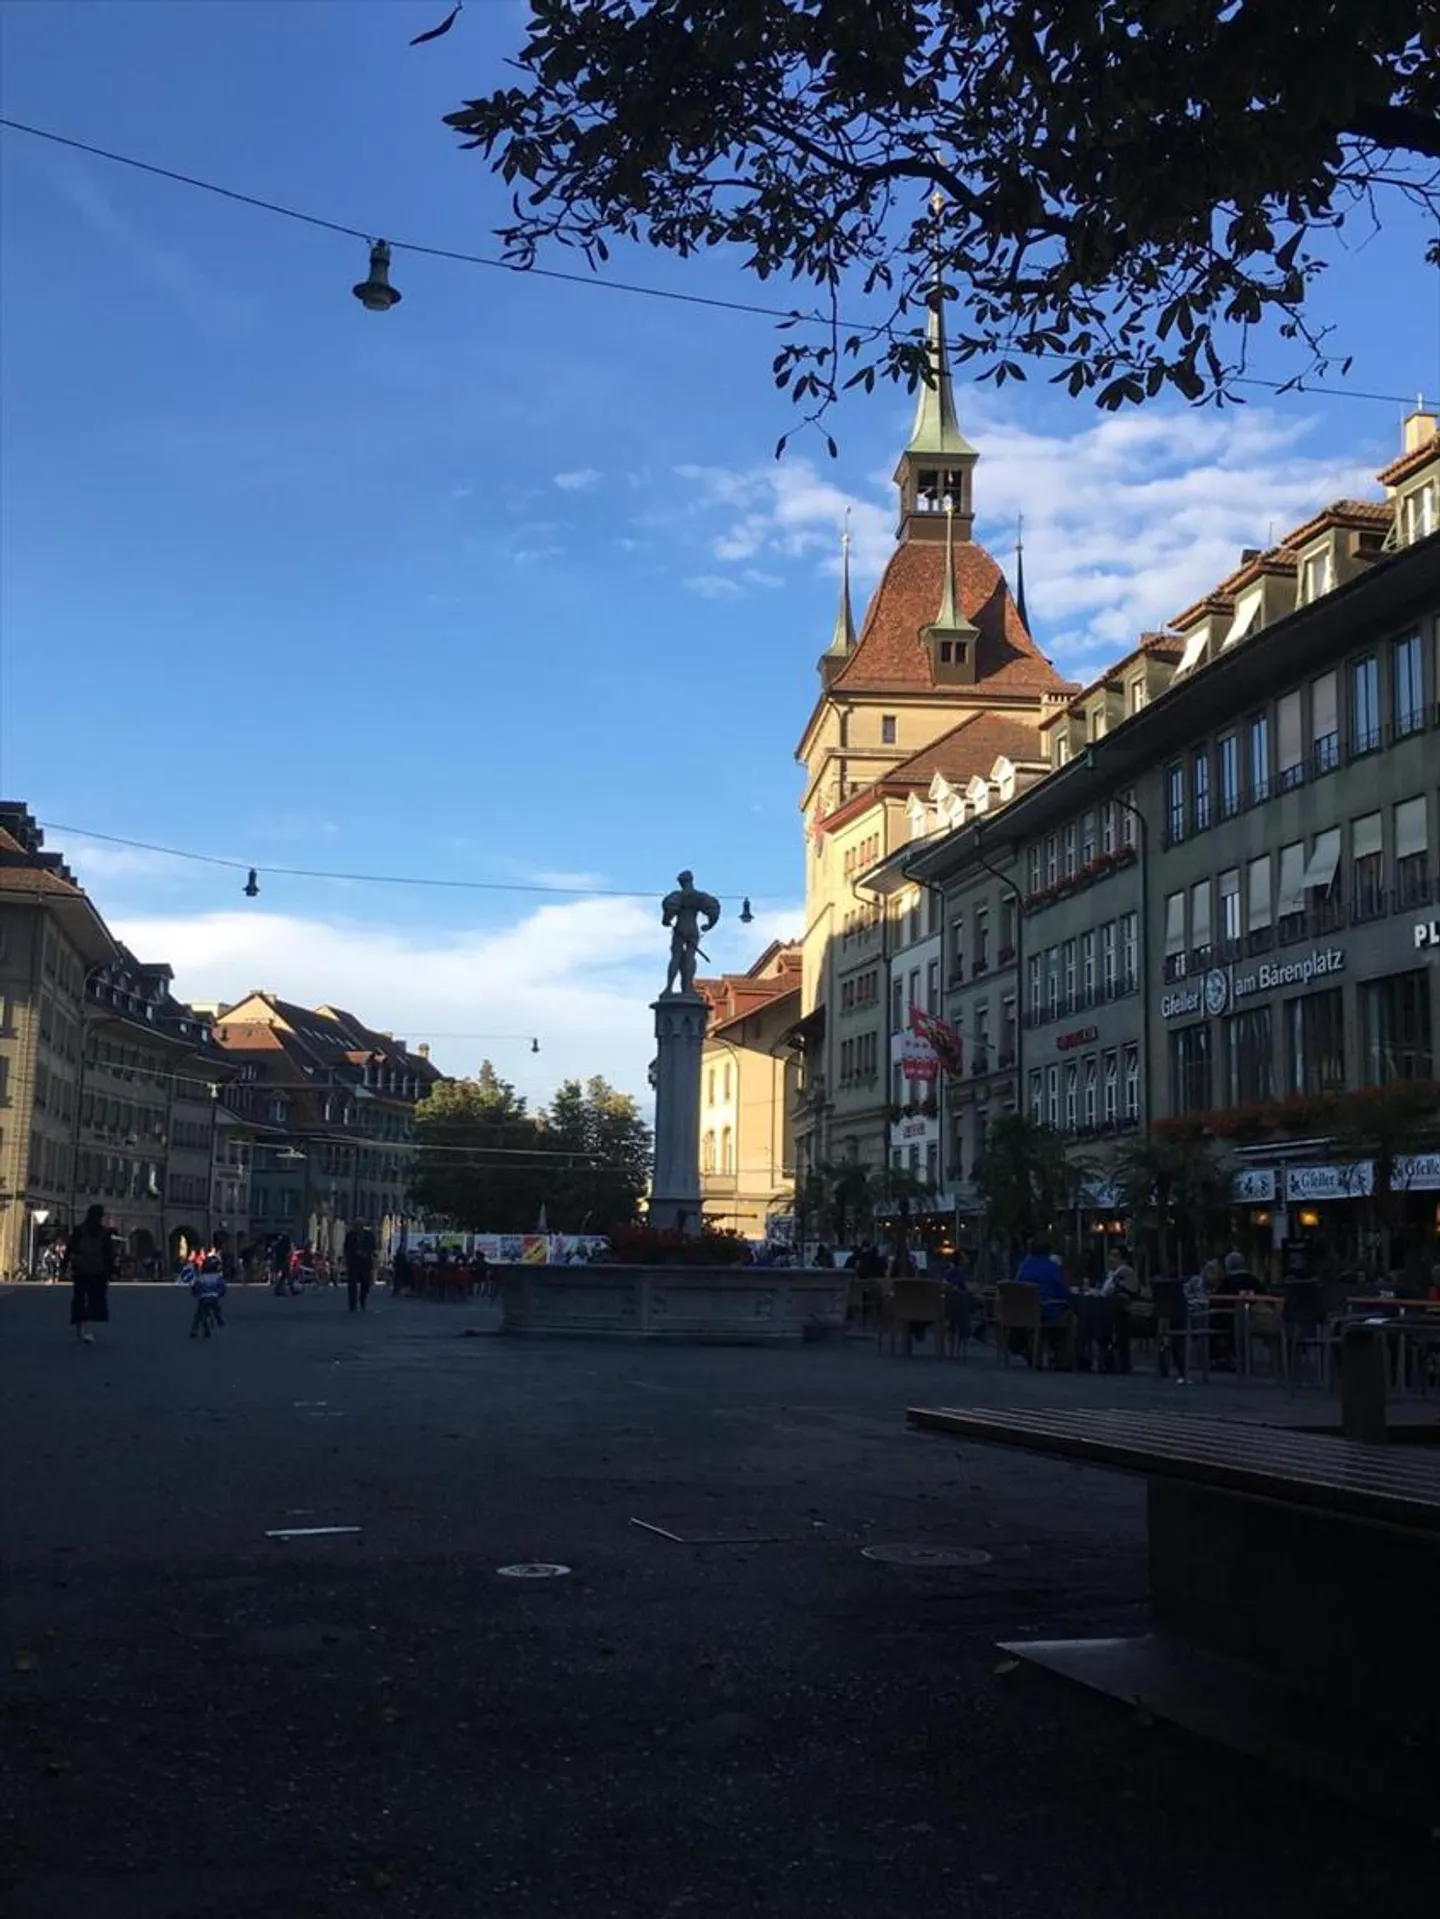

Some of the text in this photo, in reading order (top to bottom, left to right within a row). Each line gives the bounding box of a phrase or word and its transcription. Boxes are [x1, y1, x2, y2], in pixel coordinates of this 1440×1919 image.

[1414, 921, 1440, 948] PL
[1161, 949, 1343, 1018] Gfeller am Bärenplatz
